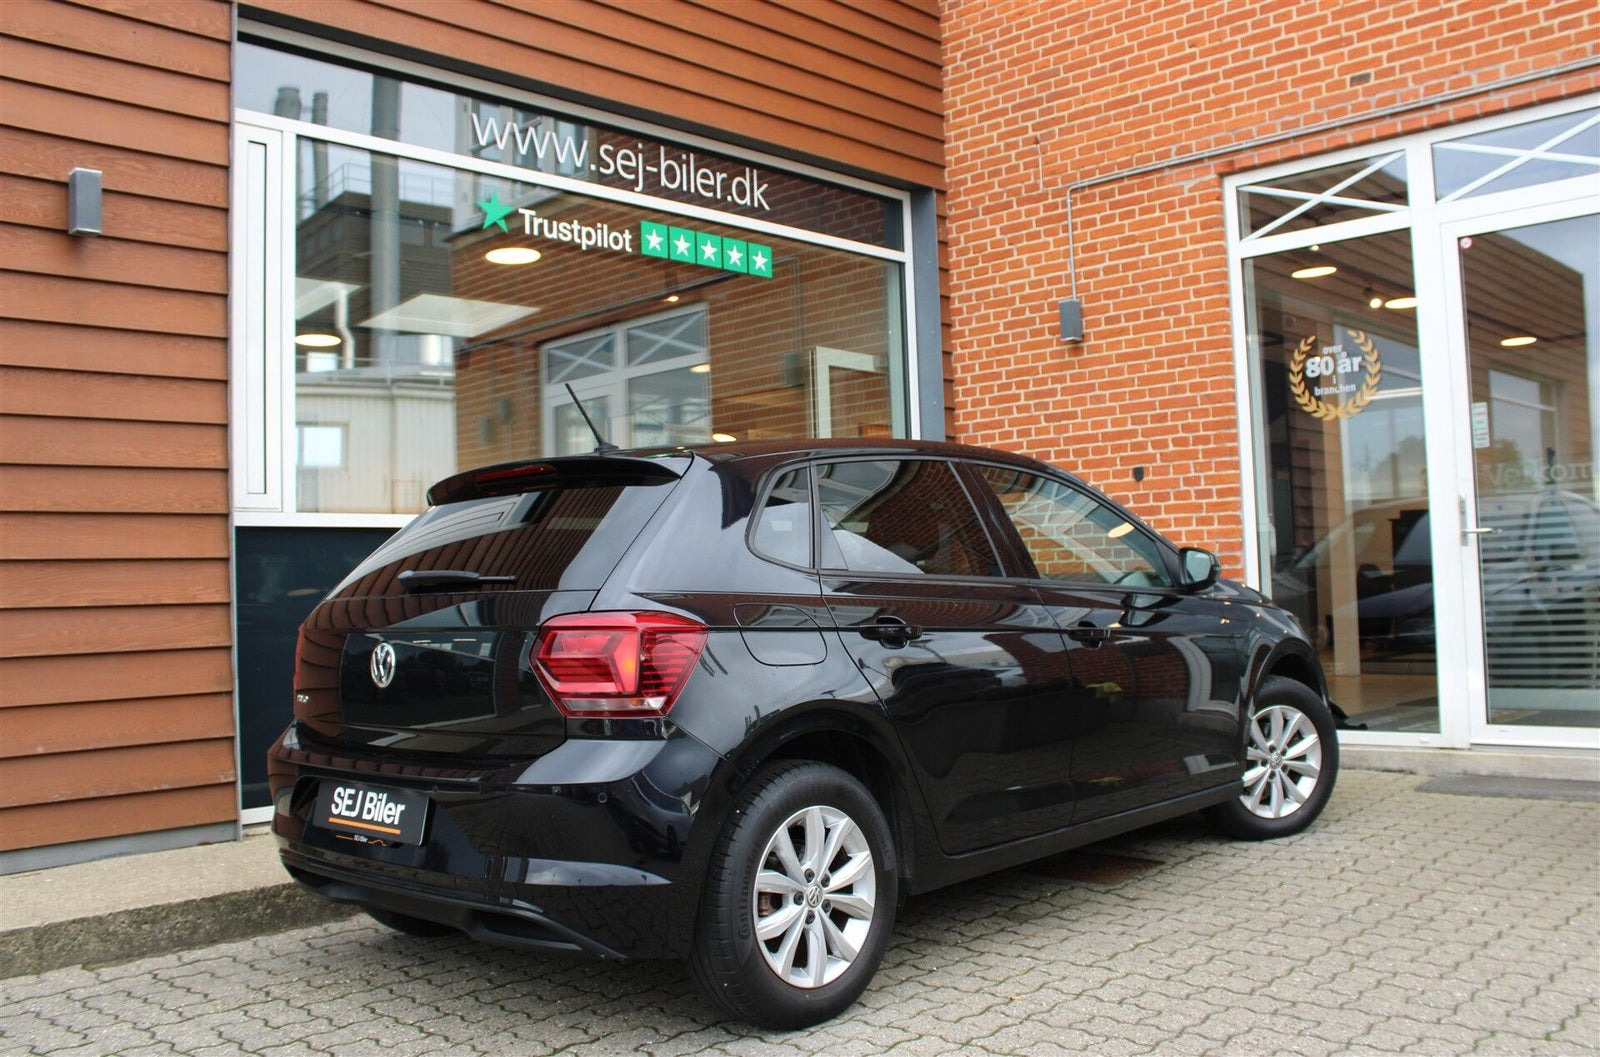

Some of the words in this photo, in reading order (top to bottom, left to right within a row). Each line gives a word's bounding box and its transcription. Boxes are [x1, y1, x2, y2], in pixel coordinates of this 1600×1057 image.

[471, 112, 771, 211] www.sej-biler.dk
[518, 208, 633, 253] Trustpilot
[1322, 344, 1343, 355] over
[1305, 355, 1335, 378] 80
[1336, 351, 1363, 374] år
[1314, 383, 1357, 396] branchen
[1332, 375, 1337, 385] i
[331, 786, 363, 818] SEJ
[362, 791, 406, 825] Biler
